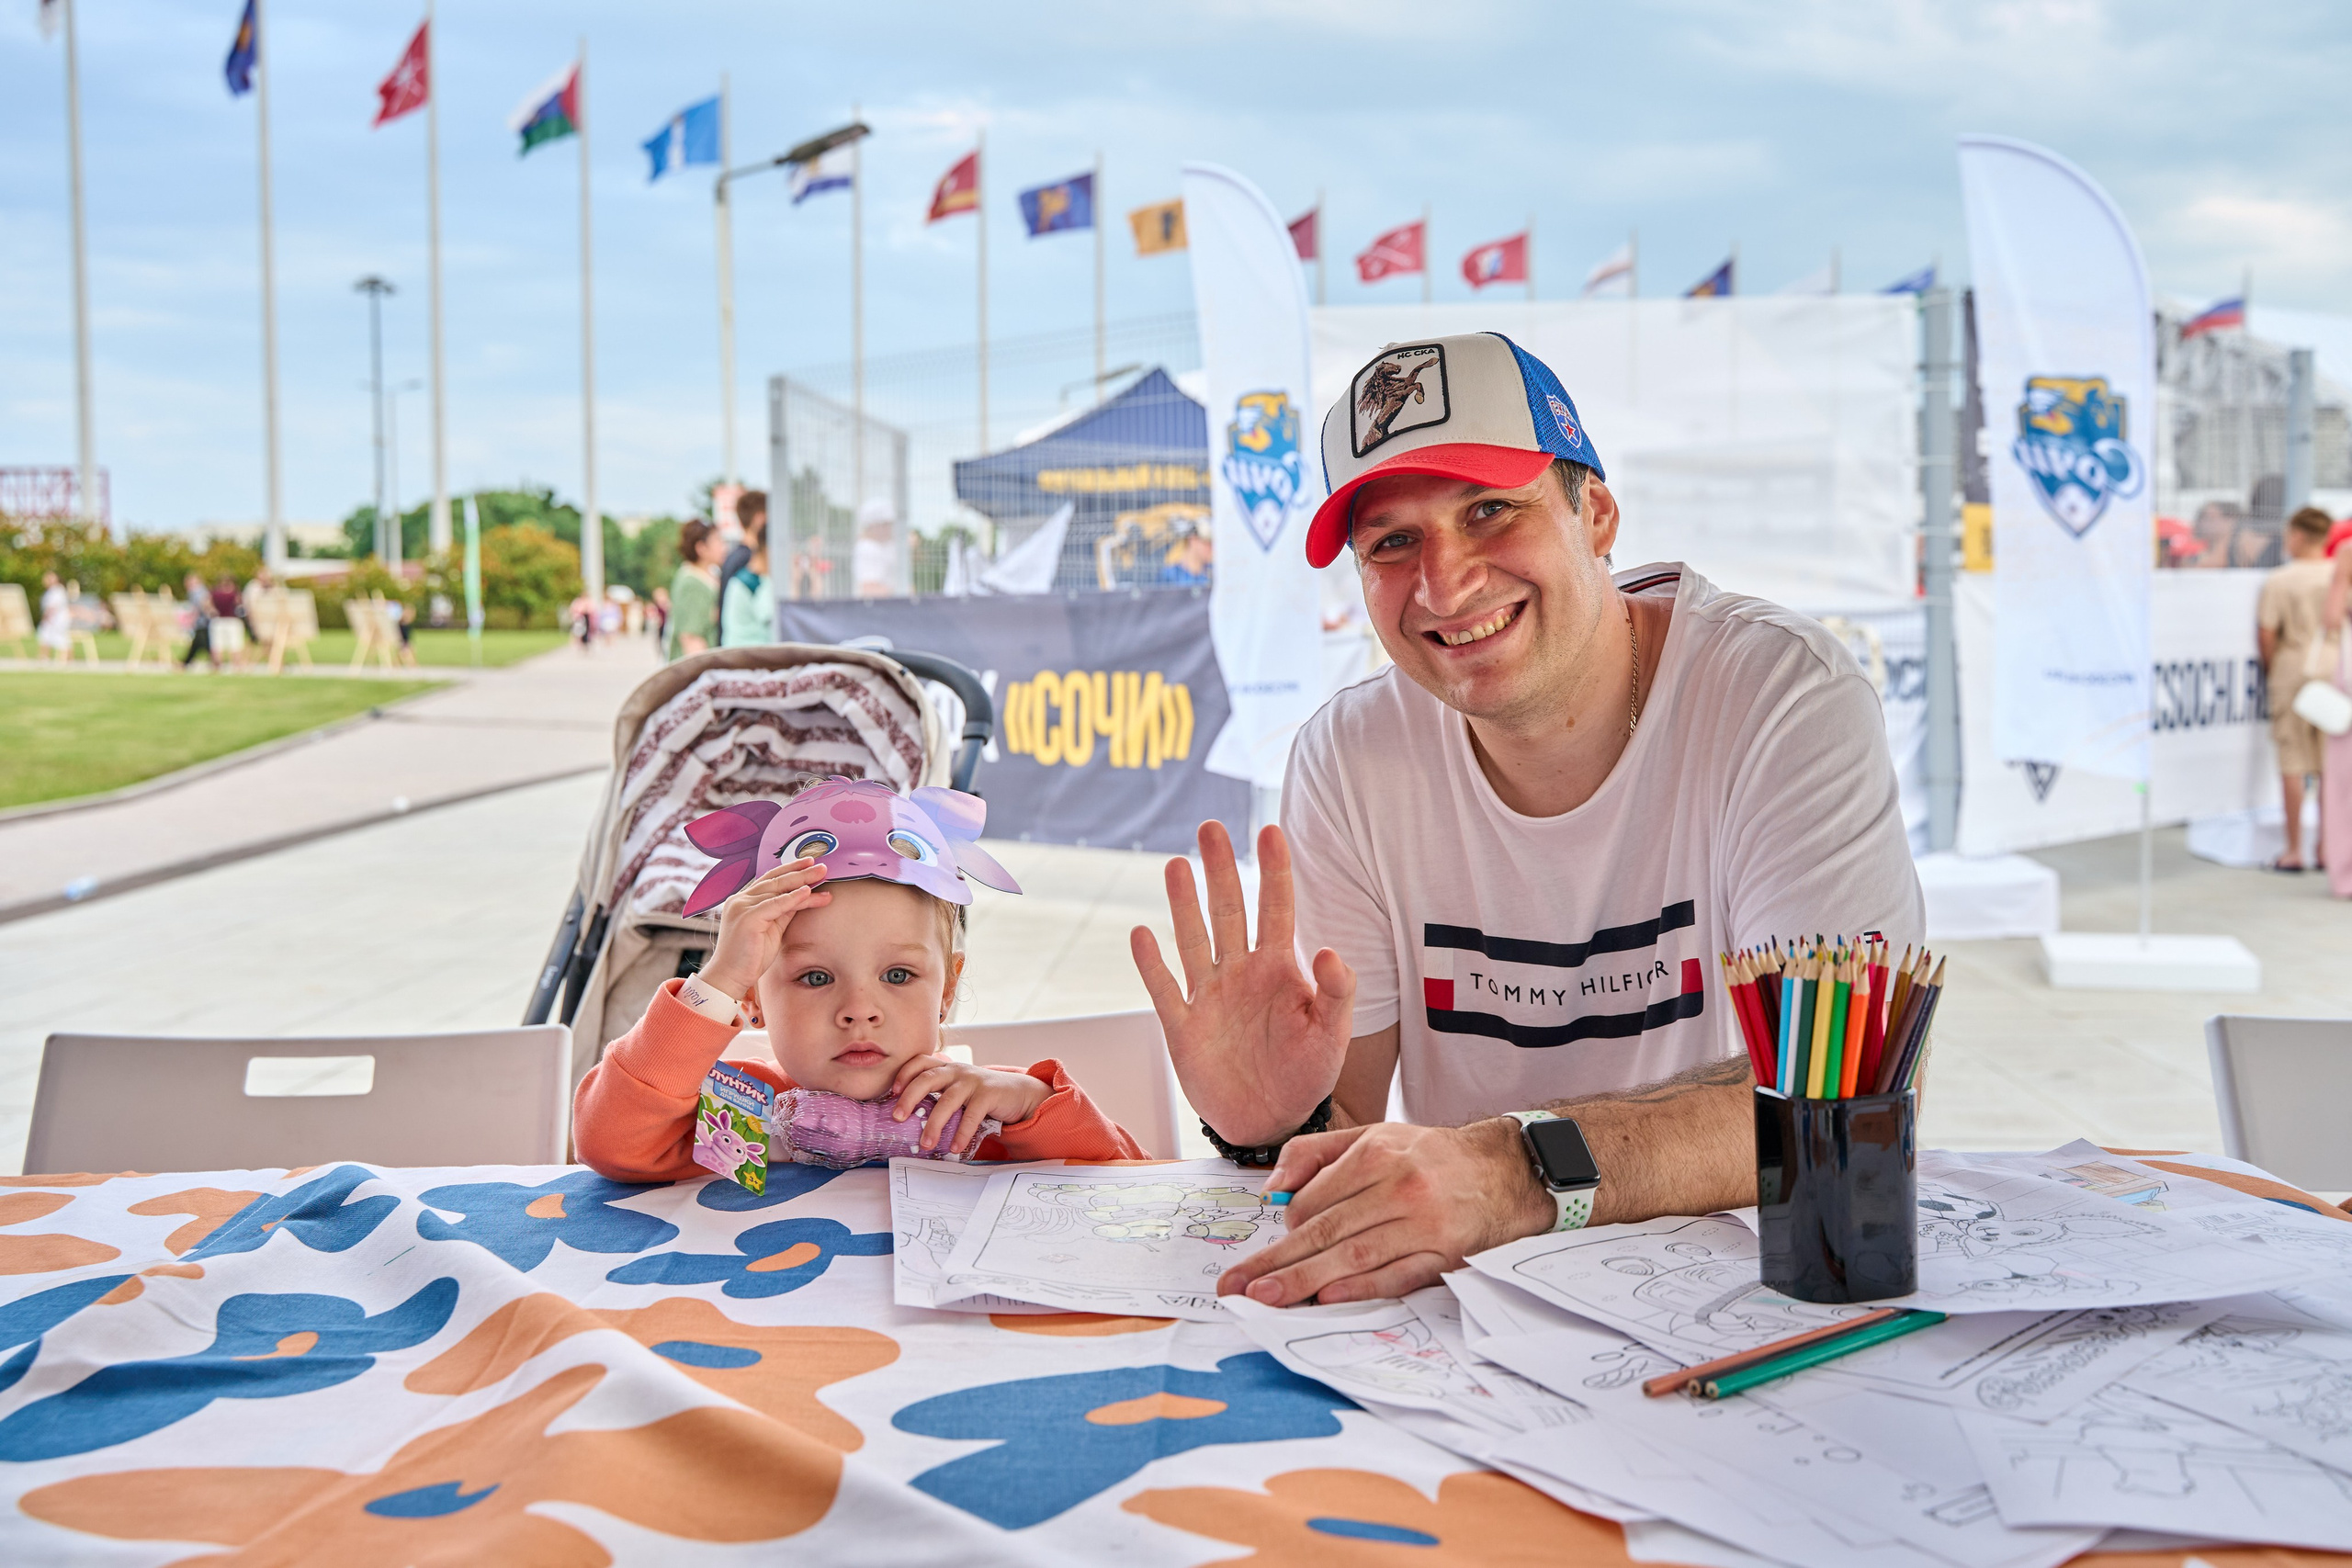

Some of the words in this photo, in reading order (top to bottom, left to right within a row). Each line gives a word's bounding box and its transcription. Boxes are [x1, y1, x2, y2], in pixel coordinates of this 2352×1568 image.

[2150, 658, 2267, 732] CSOCHI.R
[1470, 972, 1566, 1006] TOMMY
[1580, 960, 1668, 997] HILFIR
[708, 1068, 768, 1105] ЛУНТИК
[719, 1092, 733, 1100] ДЛЯ
[719, 1086, 755, 1107] ИГРУШКИ
